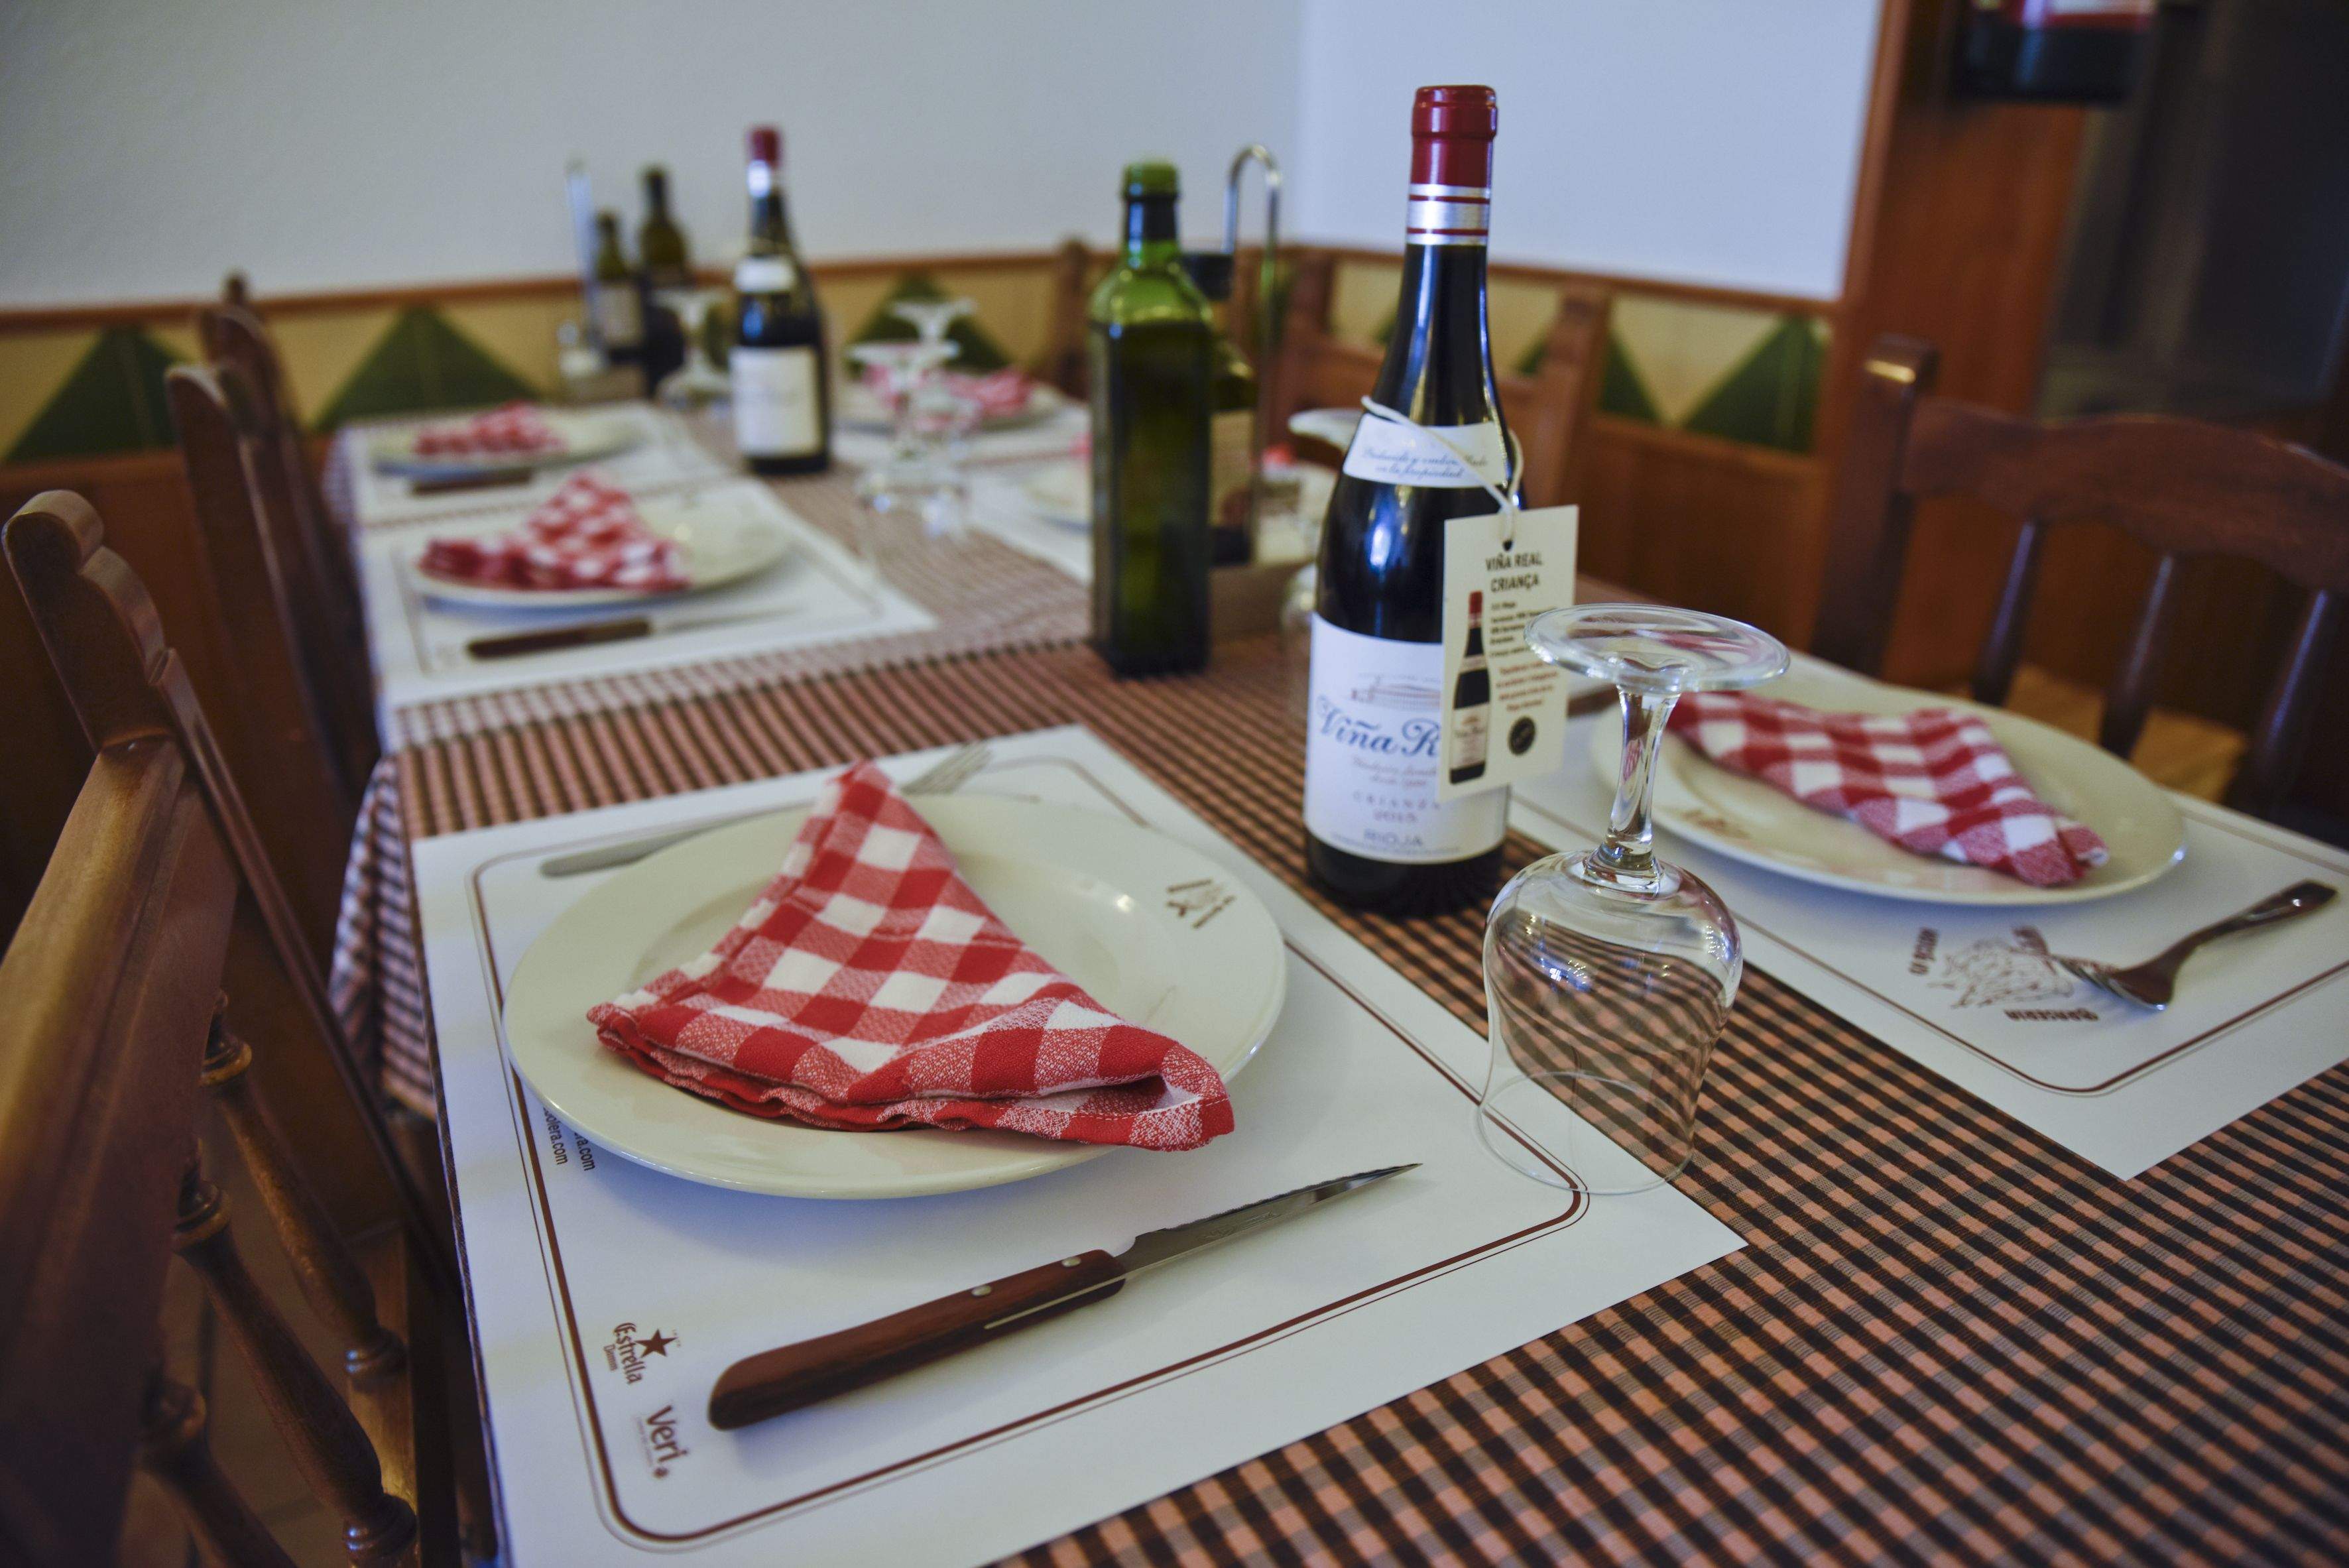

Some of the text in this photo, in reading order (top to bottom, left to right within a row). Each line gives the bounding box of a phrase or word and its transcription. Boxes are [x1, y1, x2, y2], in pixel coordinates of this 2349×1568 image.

[1515, 552, 1543, 567] REAL
[1316, 694, 1399, 754] Viña
[614, 1323, 646, 1385] Estrella
